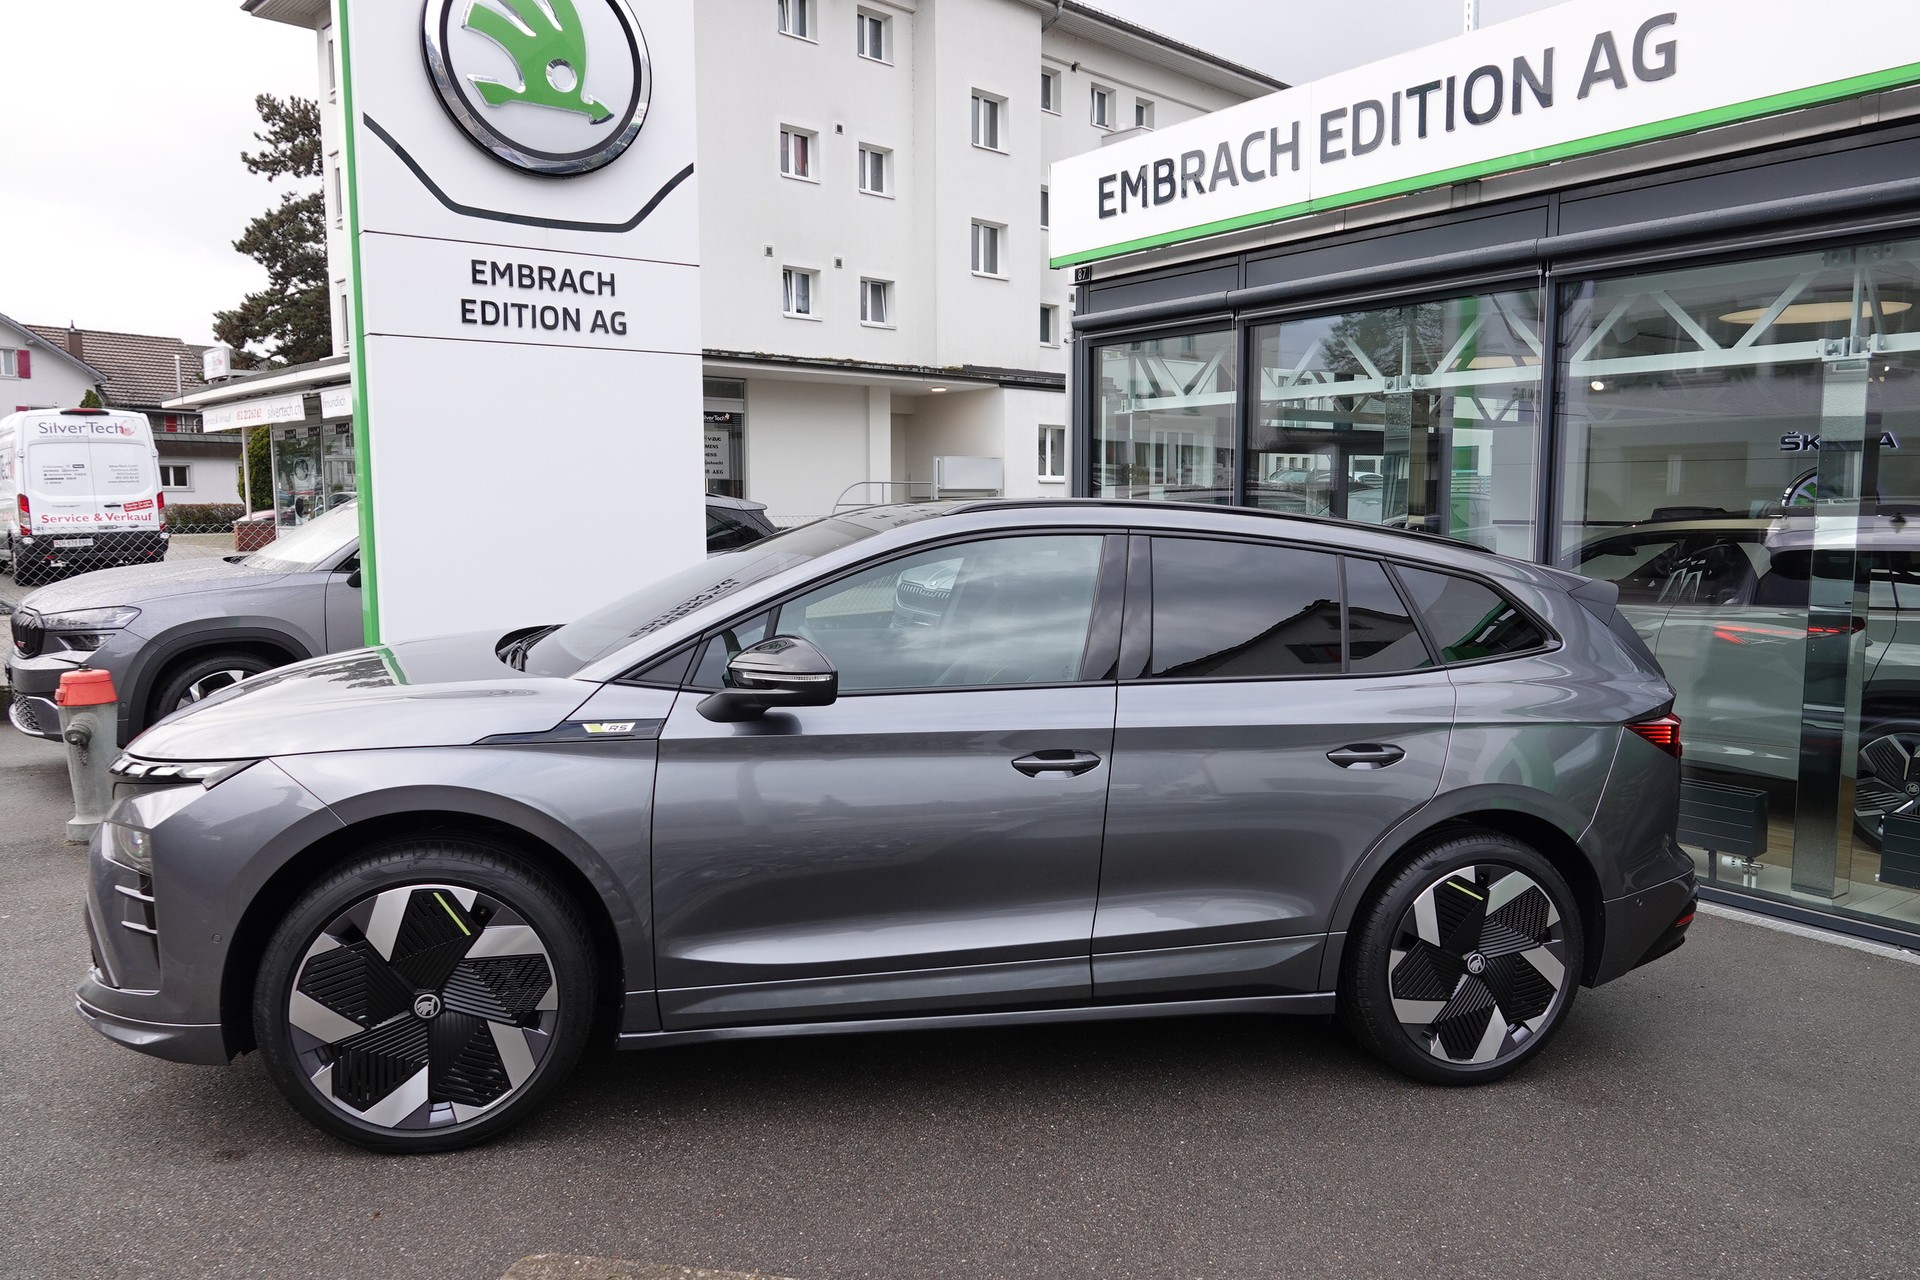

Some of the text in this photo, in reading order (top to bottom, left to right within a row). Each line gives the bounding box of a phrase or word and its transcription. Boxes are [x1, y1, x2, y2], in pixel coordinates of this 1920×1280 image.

[1098, 12, 1678, 219] EMBRACH EDITION AG
[471, 259, 616, 297] EMBRACH
[1077, 268, 1087, 280] 87
[461, 298, 627, 336] EDITION AG
[38, 421, 124, 434] SilverTech
[1780, 431, 1898, 451] ŠKA
[41, 512, 152, 524] Service & Verkauf
